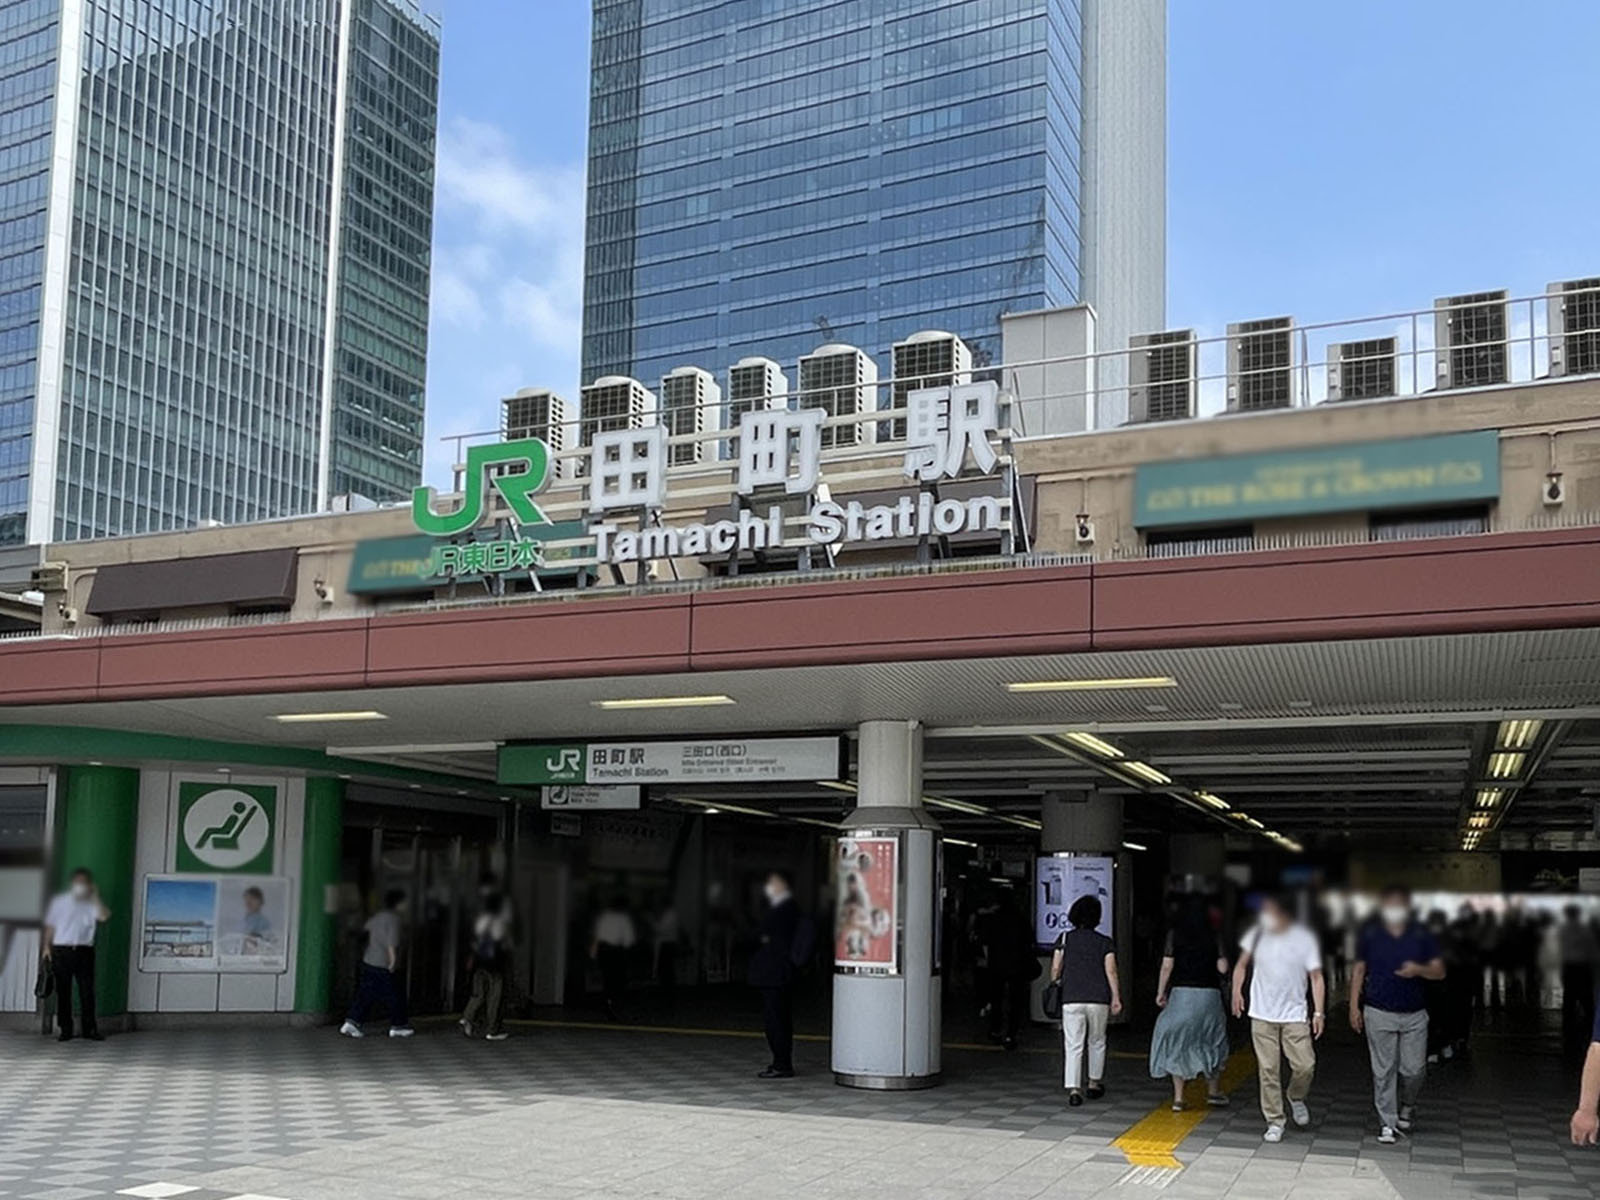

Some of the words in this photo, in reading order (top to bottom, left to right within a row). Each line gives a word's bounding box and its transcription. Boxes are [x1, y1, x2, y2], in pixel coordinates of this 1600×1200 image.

[589, 380, 1000, 514] 田町駅
[412, 437, 553, 537] JR
[589, 507, 782, 563] Tamachi
[806, 494, 1003, 545] Station
[418, 537, 540, 579] JR東日本
[546, 749, 580, 771] JR
[592, 748, 644, 765] 田町駅
[592, 768, 632, 778] Tamachi
[634, 767, 669, 777] Station
